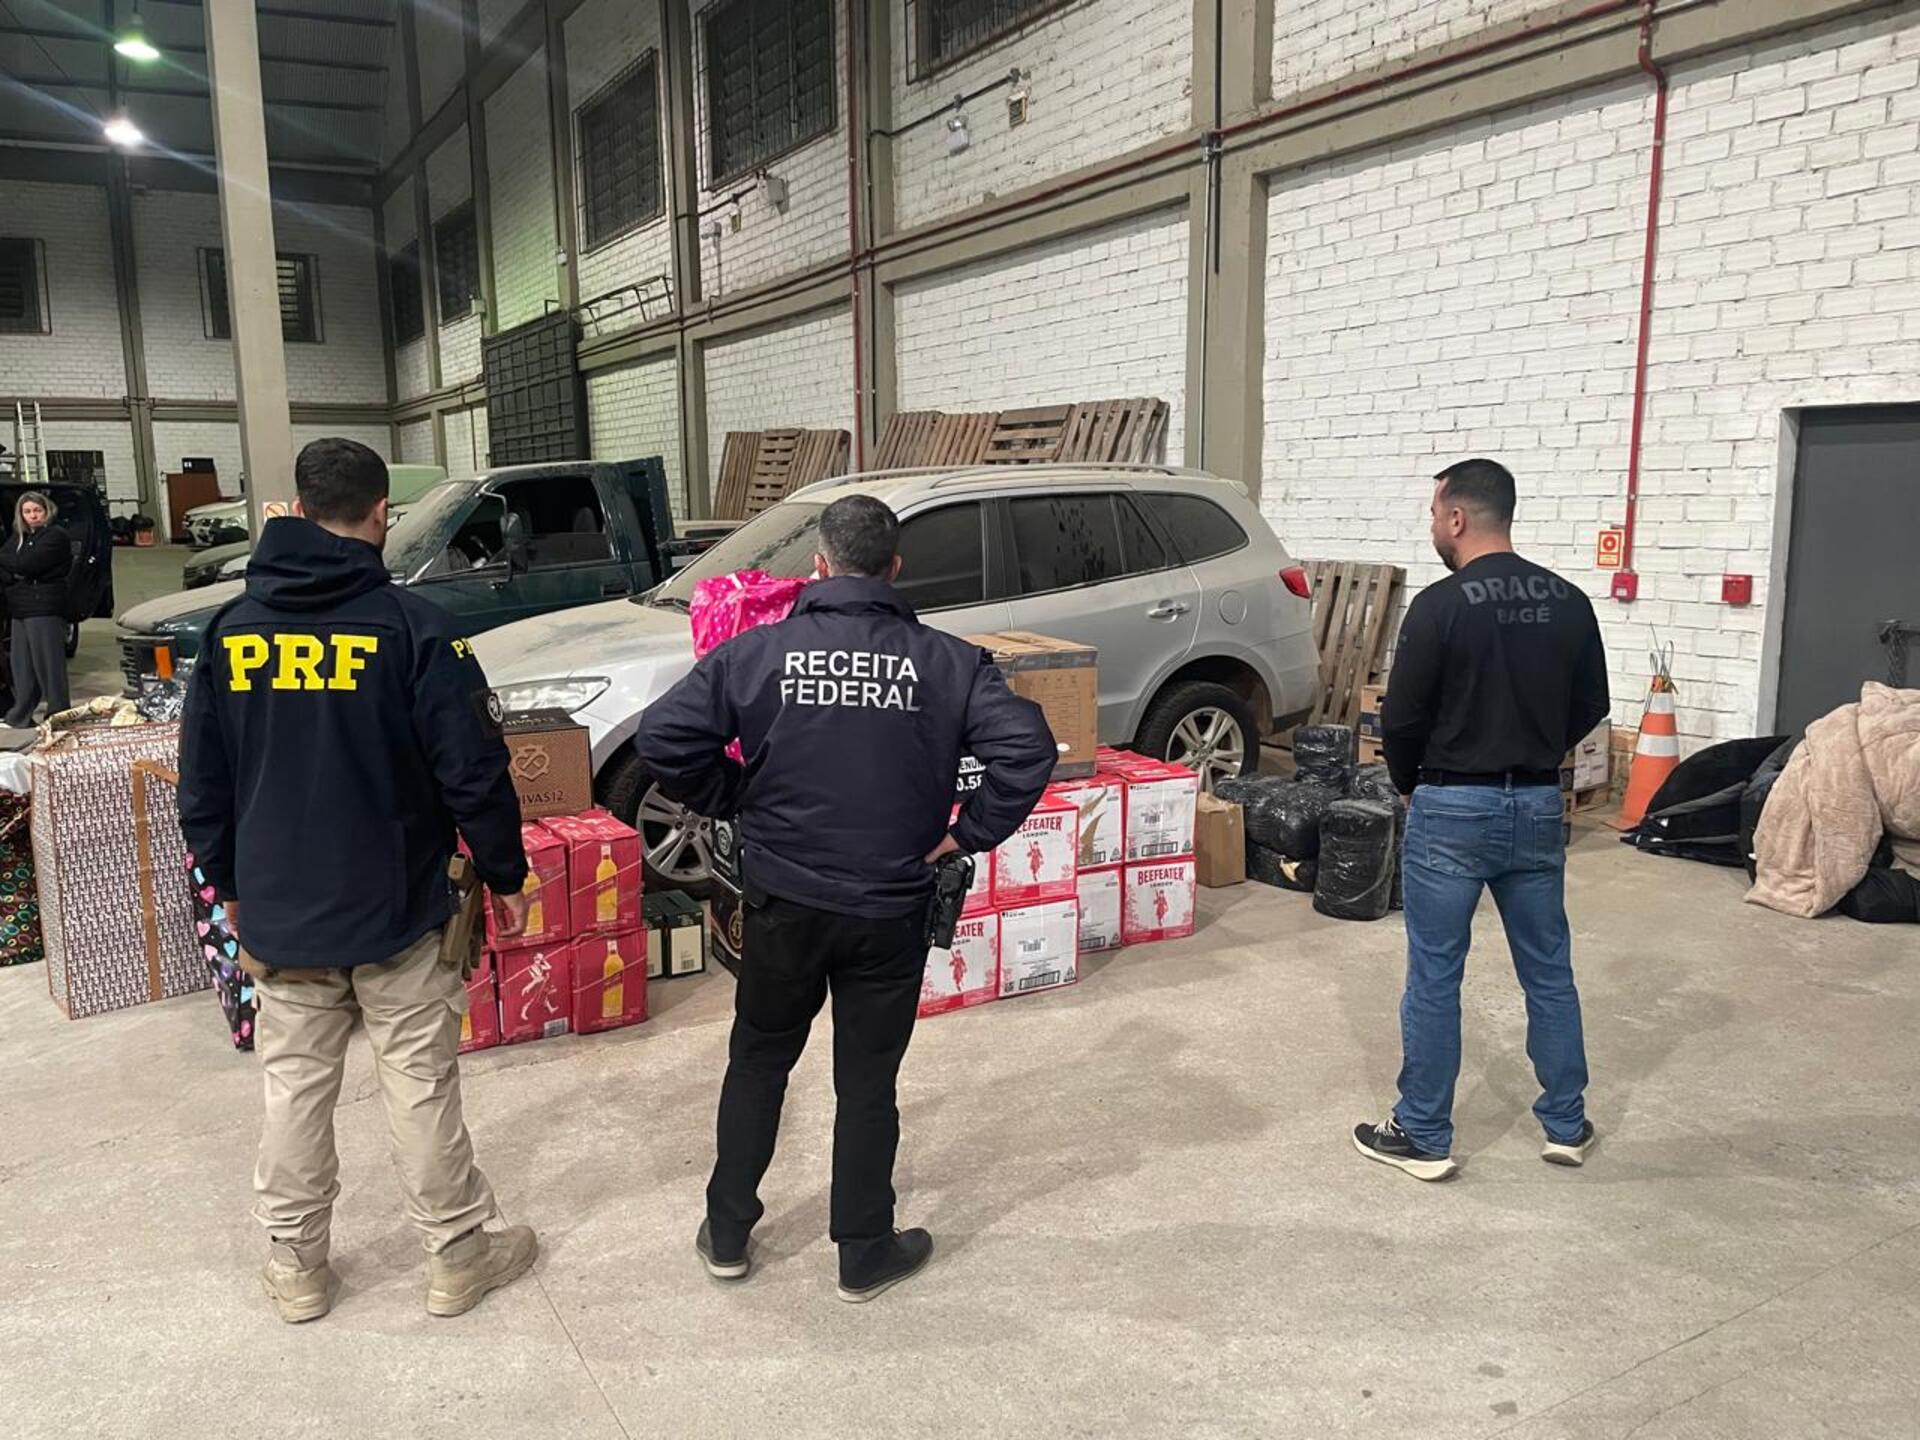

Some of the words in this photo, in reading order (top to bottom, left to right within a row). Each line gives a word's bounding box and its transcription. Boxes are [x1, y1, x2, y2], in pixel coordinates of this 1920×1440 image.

[1461, 576, 1569, 605] DRACO
[222, 633, 379, 691] PRF
[785, 650, 918, 682] RECEITA
[780, 678, 921, 712] FEDERAL
[522, 790, 564, 805] IVAS12
[1137, 866, 1184, 886] BEEFEATER
